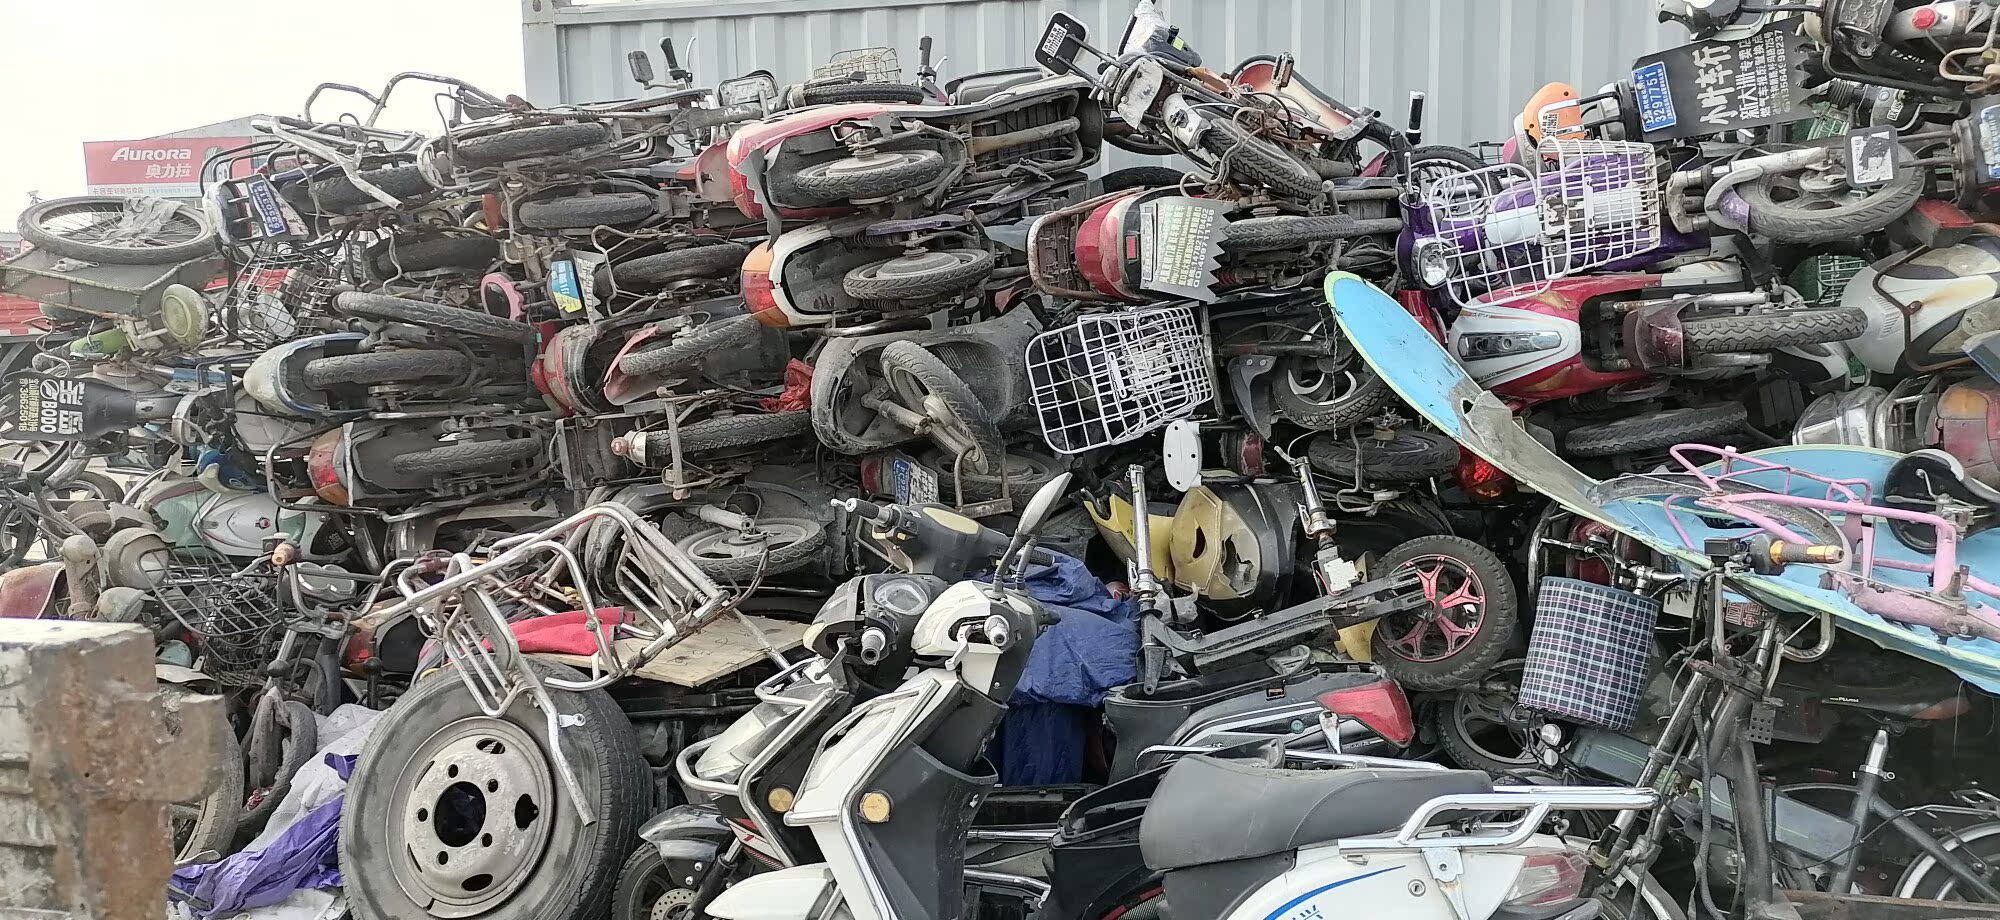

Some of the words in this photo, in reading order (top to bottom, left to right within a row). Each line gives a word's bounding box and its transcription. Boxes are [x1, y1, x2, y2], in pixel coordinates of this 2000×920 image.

[1645, 71, 1667, 123] 3297751
[1692, 45, 1739, 125] 小叶车行
[1735, 38, 1760, 121] 新大洲专卖店
[145, 163, 192, 179] 奥力拉
[1193, 209, 1215, 288] QQ:409711158
[40, 401, 58, 433] BODO
